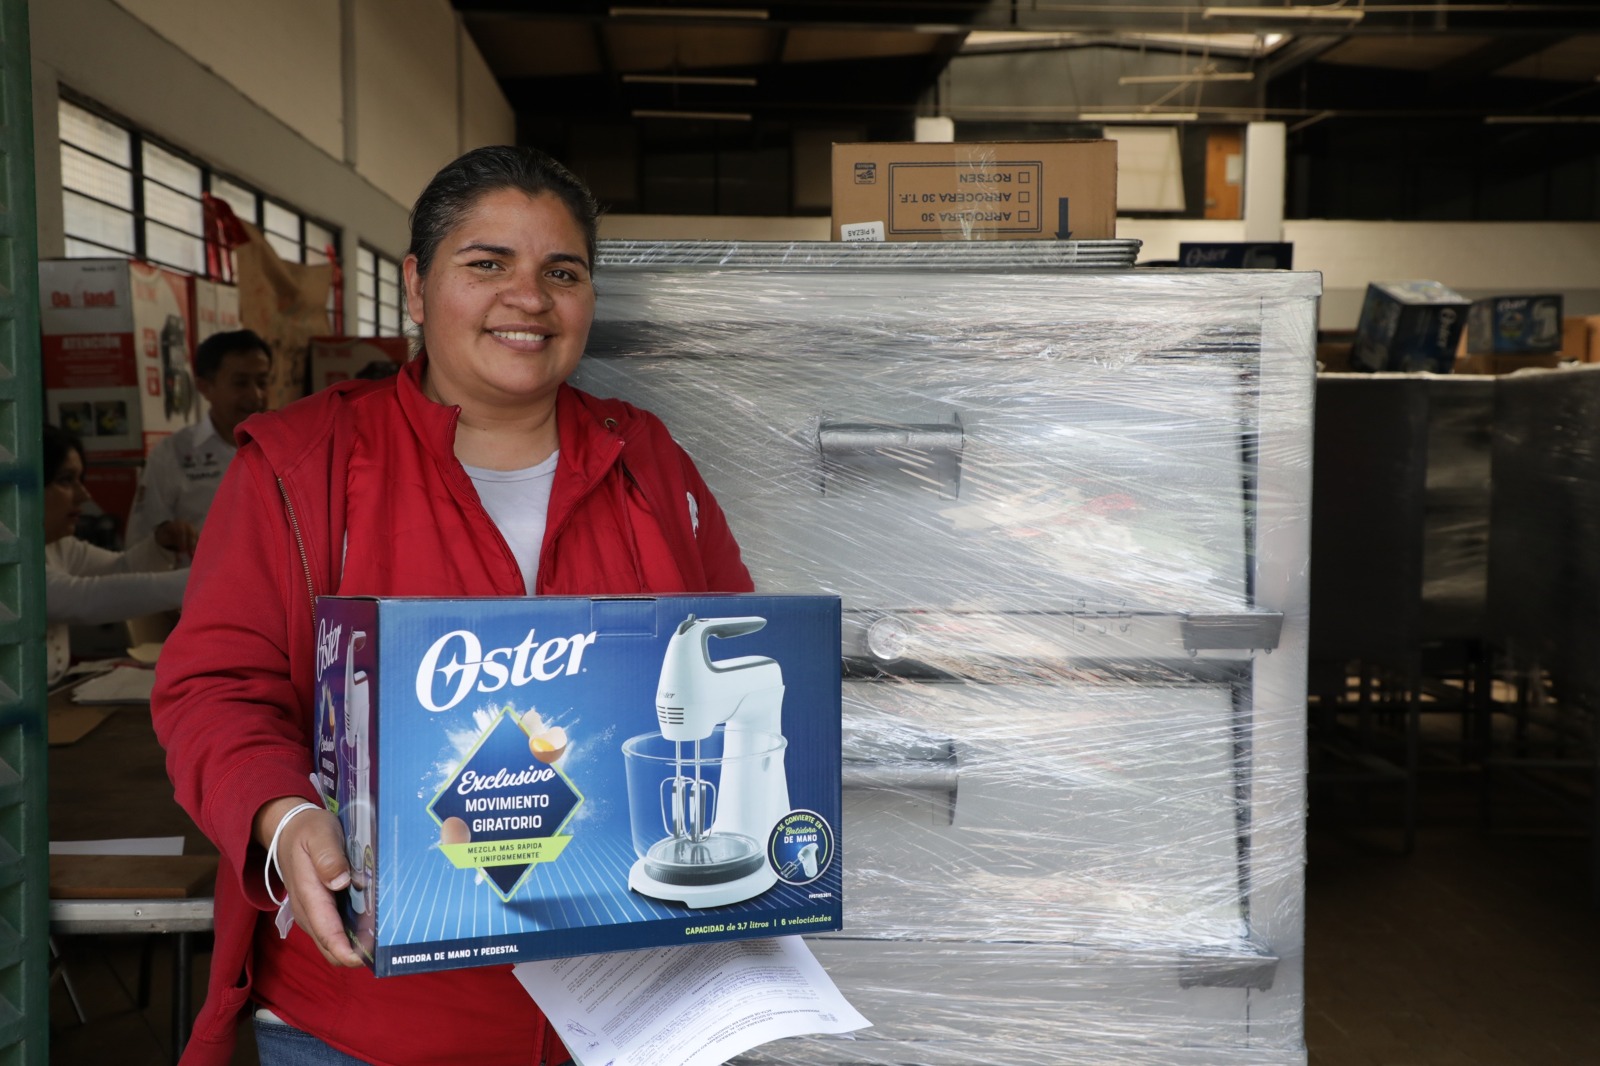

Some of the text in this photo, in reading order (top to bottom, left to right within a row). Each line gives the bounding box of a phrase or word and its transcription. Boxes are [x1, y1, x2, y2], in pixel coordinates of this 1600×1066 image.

[959, 173, 1012, 183] ROTSEN
[922, 194, 936, 203] 30
[939, 193, 1012, 203] ARROCERA
[921, 212, 1012, 222] ARROCERA 30
[317, 618, 342, 682] Oster
[415, 629, 597, 712] Oster
[457, 765, 556, 795] Exclusivo
[465, 795, 549, 812] MOVIMIENTO
[472, 815, 542, 832] GIRATORIO
[785, 814, 816, 825] CONVIERTE
[815, 821, 823, 829] EN
[786, 827, 817, 835] Batidora
[797, 834, 817, 842] MANO
[468, 846, 496, 854] MEZCLA
[481, 852, 540, 862] UNIFORMEMENTE
[685, 925, 725, 935] CAPACIDAD
[726, 923, 736, 931] de
[737, 922, 747, 930] 3,7
[750, 921, 769, 929] litros
[788, 915, 832, 925] velocidades
[392, 954, 431, 965] BATIDORA
[435, 952, 445, 960] DE
[448, 950, 471, 959] MANO
[481, 945, 519, 956] PEDESTAL
